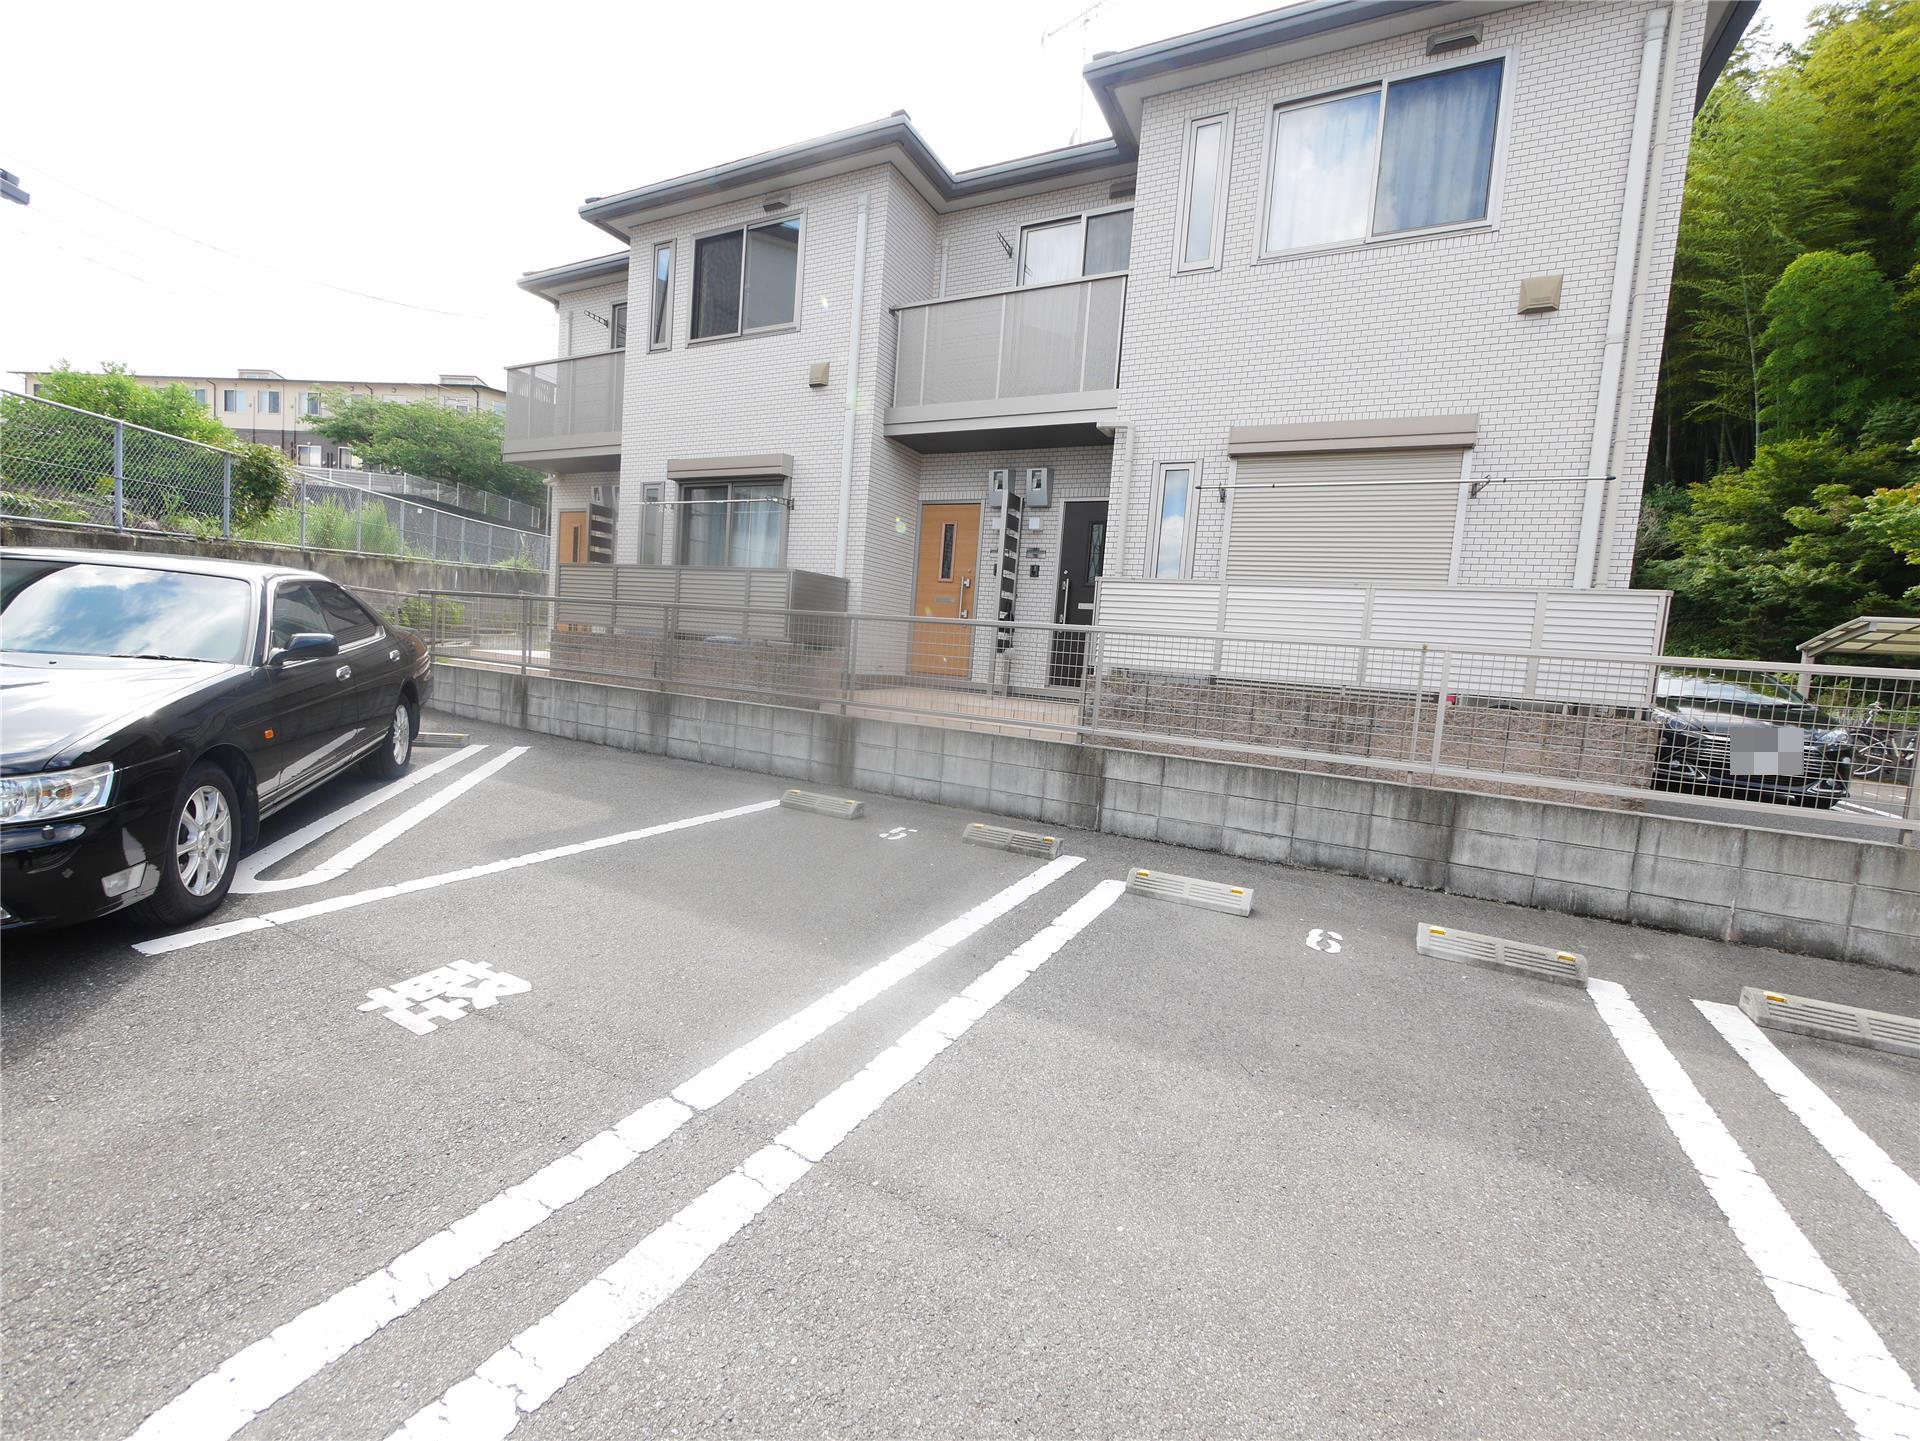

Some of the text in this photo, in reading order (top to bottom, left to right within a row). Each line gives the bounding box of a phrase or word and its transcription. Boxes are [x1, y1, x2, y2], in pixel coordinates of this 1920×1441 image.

[879, 827, 918, 840] 5
[1305, 928, 1344, 954] 6
[356, 958, 533, 1036] 軽
